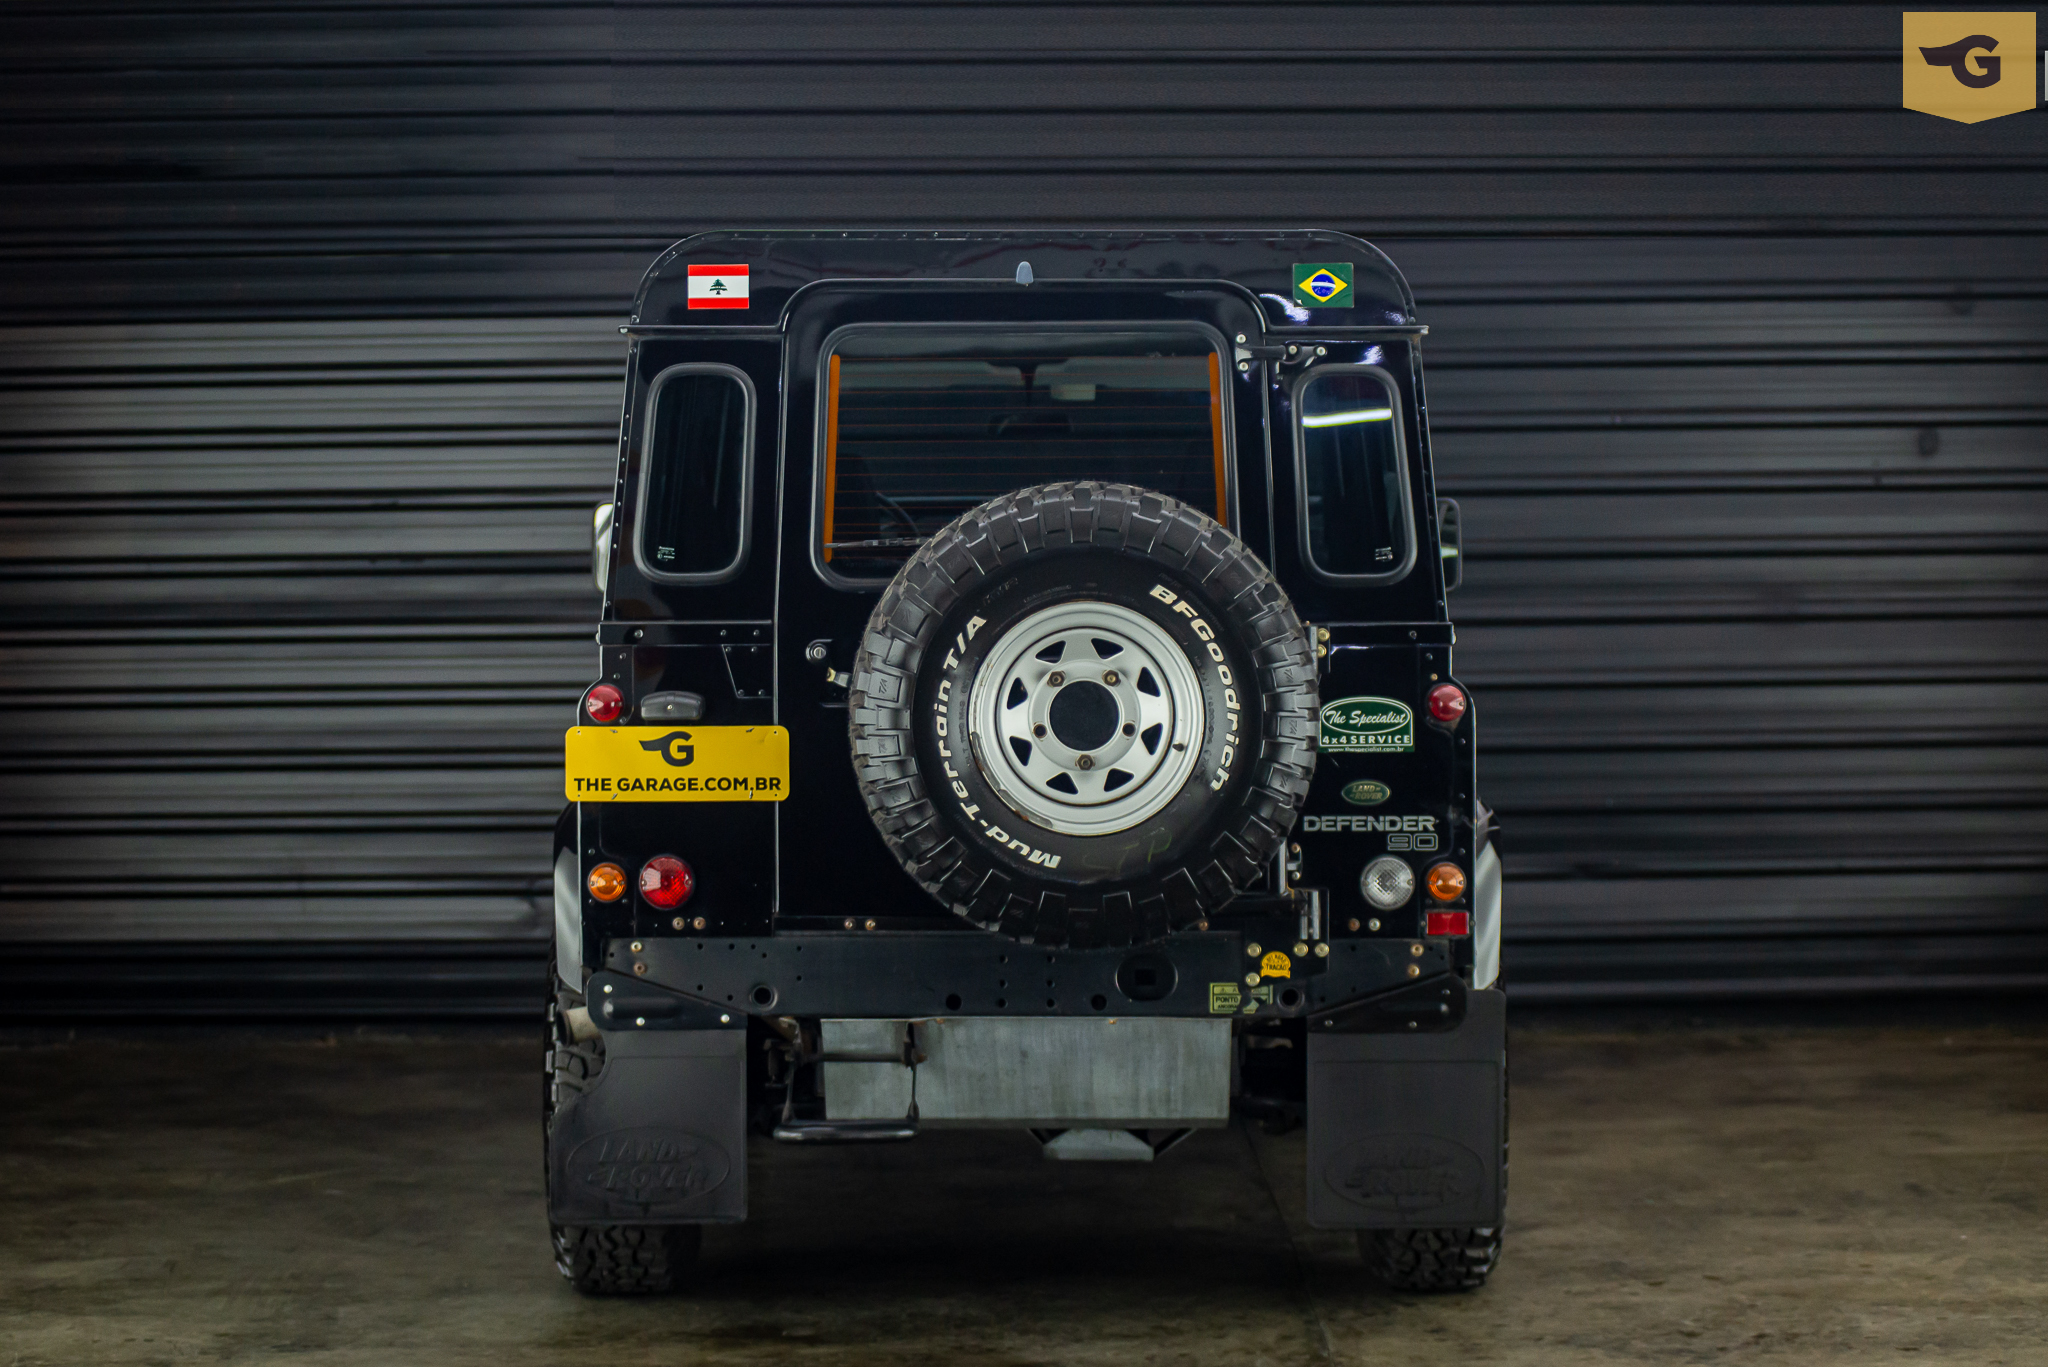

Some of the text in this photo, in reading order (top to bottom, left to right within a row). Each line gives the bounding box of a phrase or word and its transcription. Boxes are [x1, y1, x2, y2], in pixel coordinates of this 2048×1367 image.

[943, 615, 987, 669] T/A
[1149, 585, 1240, 791] BFGoodrich
[1325, 710, 1407, 727] The Specialist
[1322, 735, 1411, 744] 4x4 SERVICE
[661, 731, 695, 767] G
[934, 679, 1061, 869] Mud-Terrain
[574, 777, 782, 792] THE GARAGE.COM.BR
[1352, 785, 1375, 793] LAND
[1355, 792, 1383, 800] ROVER
[1303, 815, 1436, 832] DEFENDER
[1387, 833, 1439, 851] 90
